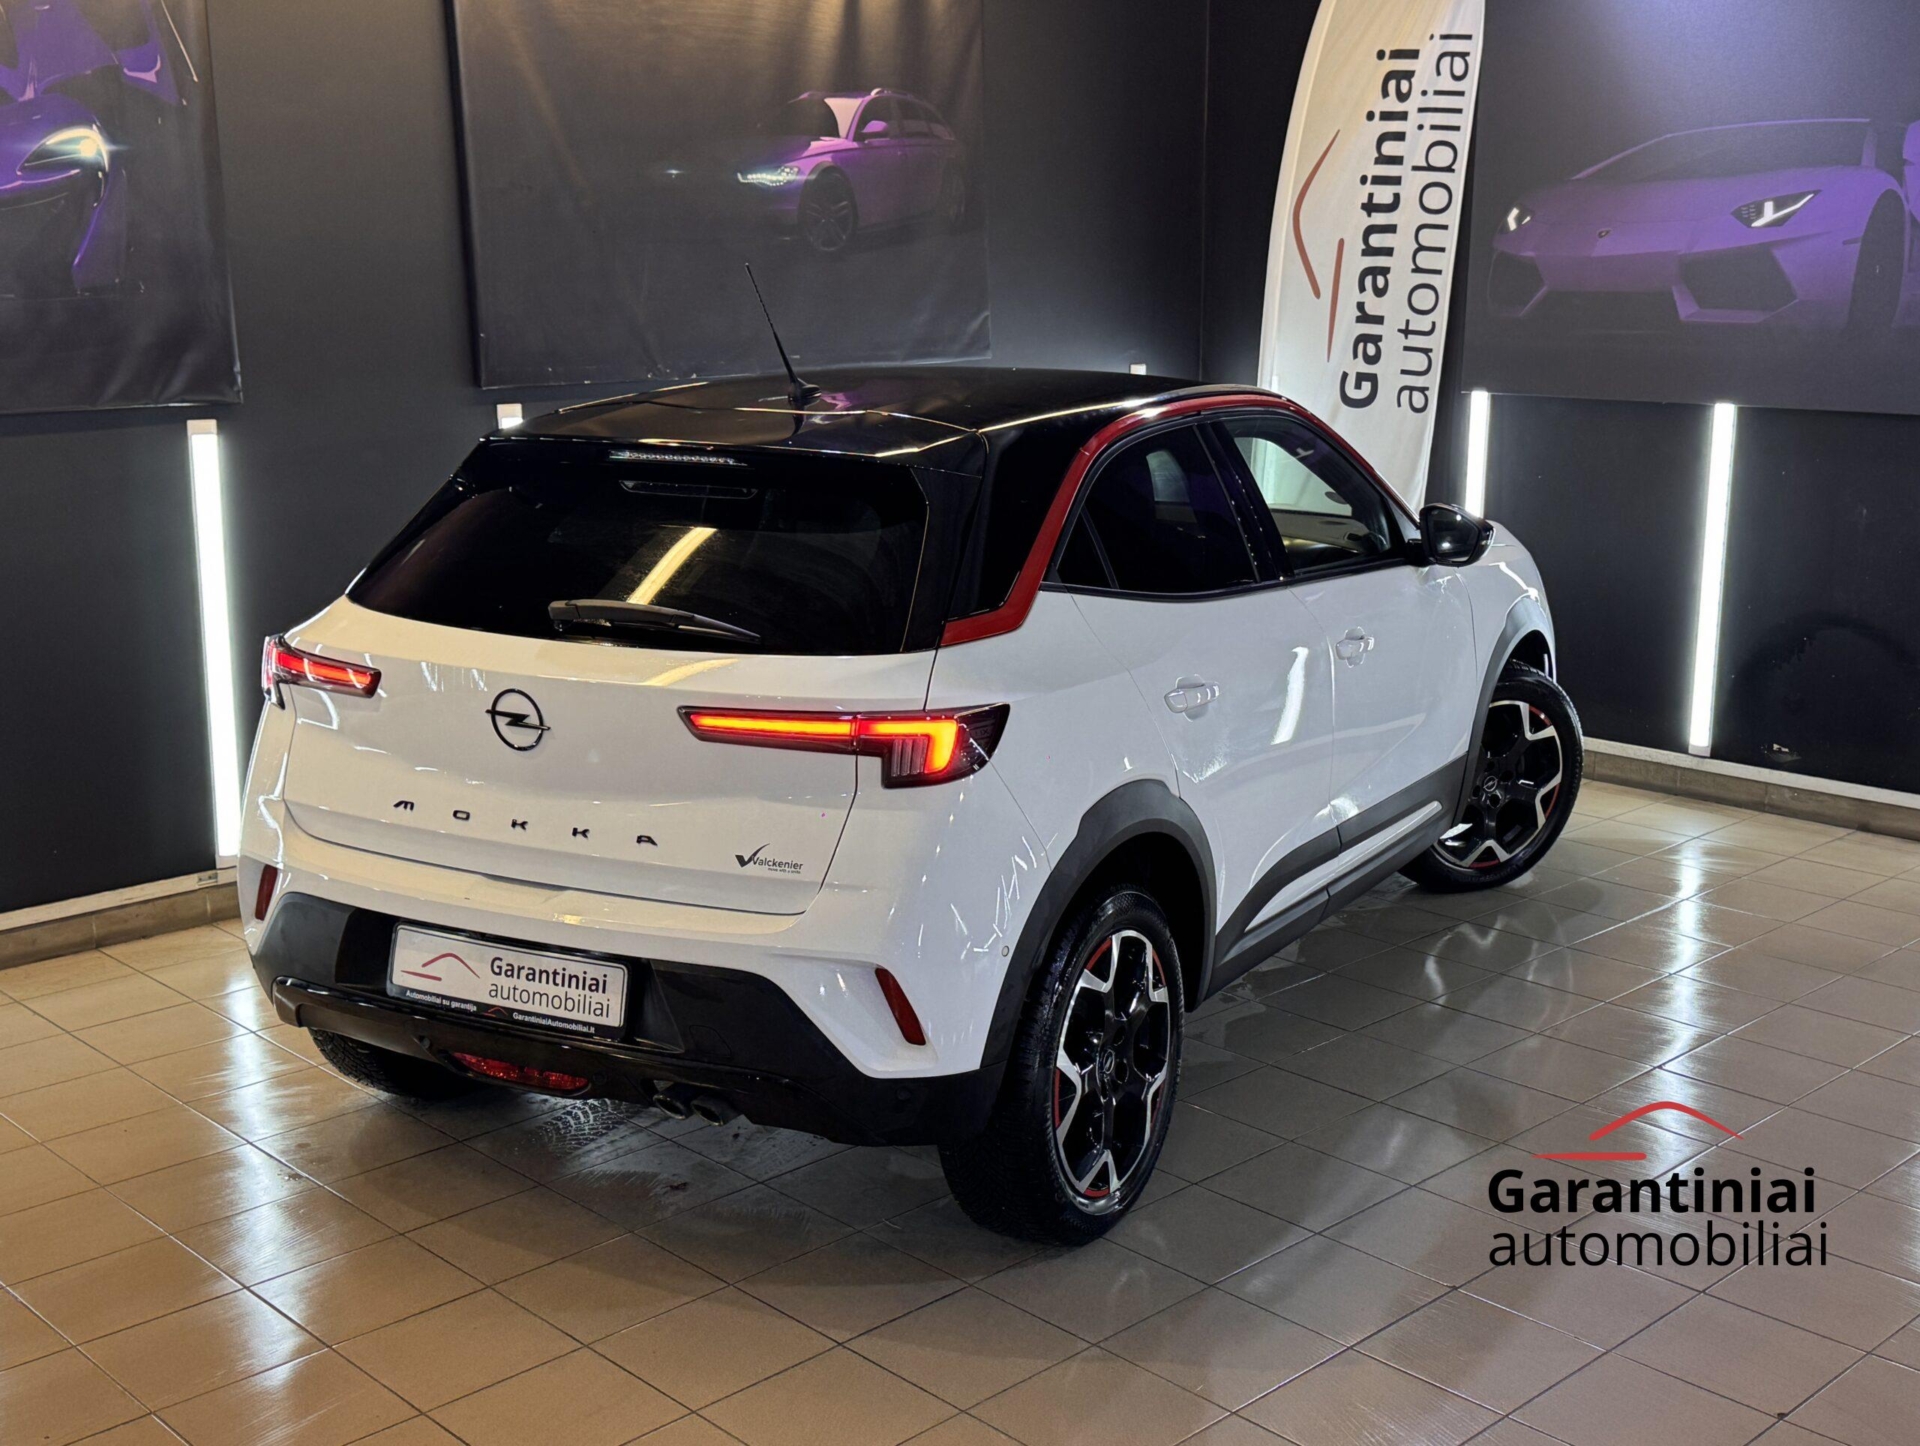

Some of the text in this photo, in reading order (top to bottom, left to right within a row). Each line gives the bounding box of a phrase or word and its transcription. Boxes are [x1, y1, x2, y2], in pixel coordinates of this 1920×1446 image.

[1340, 48, 1420, 408] Garantiniai
[1396, 33, 1473, 413] automobiliai
[393, 799, 658, 846] MOKKA
[752, 856, 803, 870] Valckenier
[490, 957, 607, 994] Garantiniai
[406, 989, 441, 1004] Automobiliai
[489, 982, 610, 1018] automobiliai
